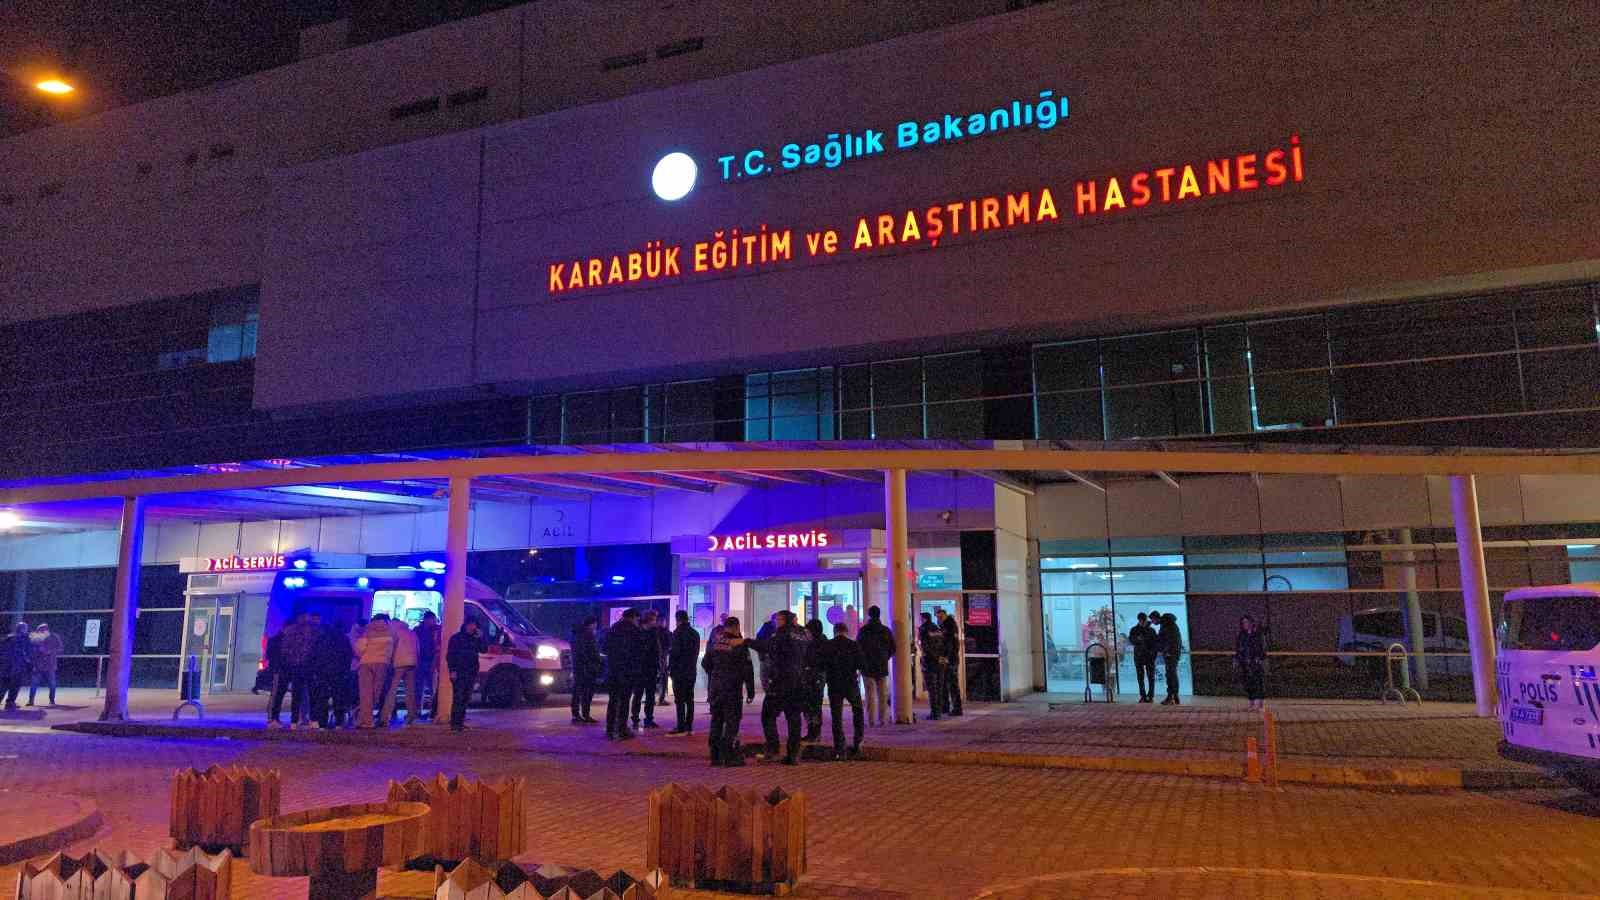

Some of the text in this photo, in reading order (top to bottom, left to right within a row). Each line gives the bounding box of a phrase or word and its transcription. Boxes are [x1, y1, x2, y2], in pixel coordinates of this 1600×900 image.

[718, 90, 1069, 181] T.C. Sağlık Bakanlığı
[549, 135, 1304, 293] KARABÜK EĞİTİM ve ARAŞTIRMA HASTANESİ
[766, 530, 828, 549] SERVİS
[1520, 680, 1558, 702] POLİS
